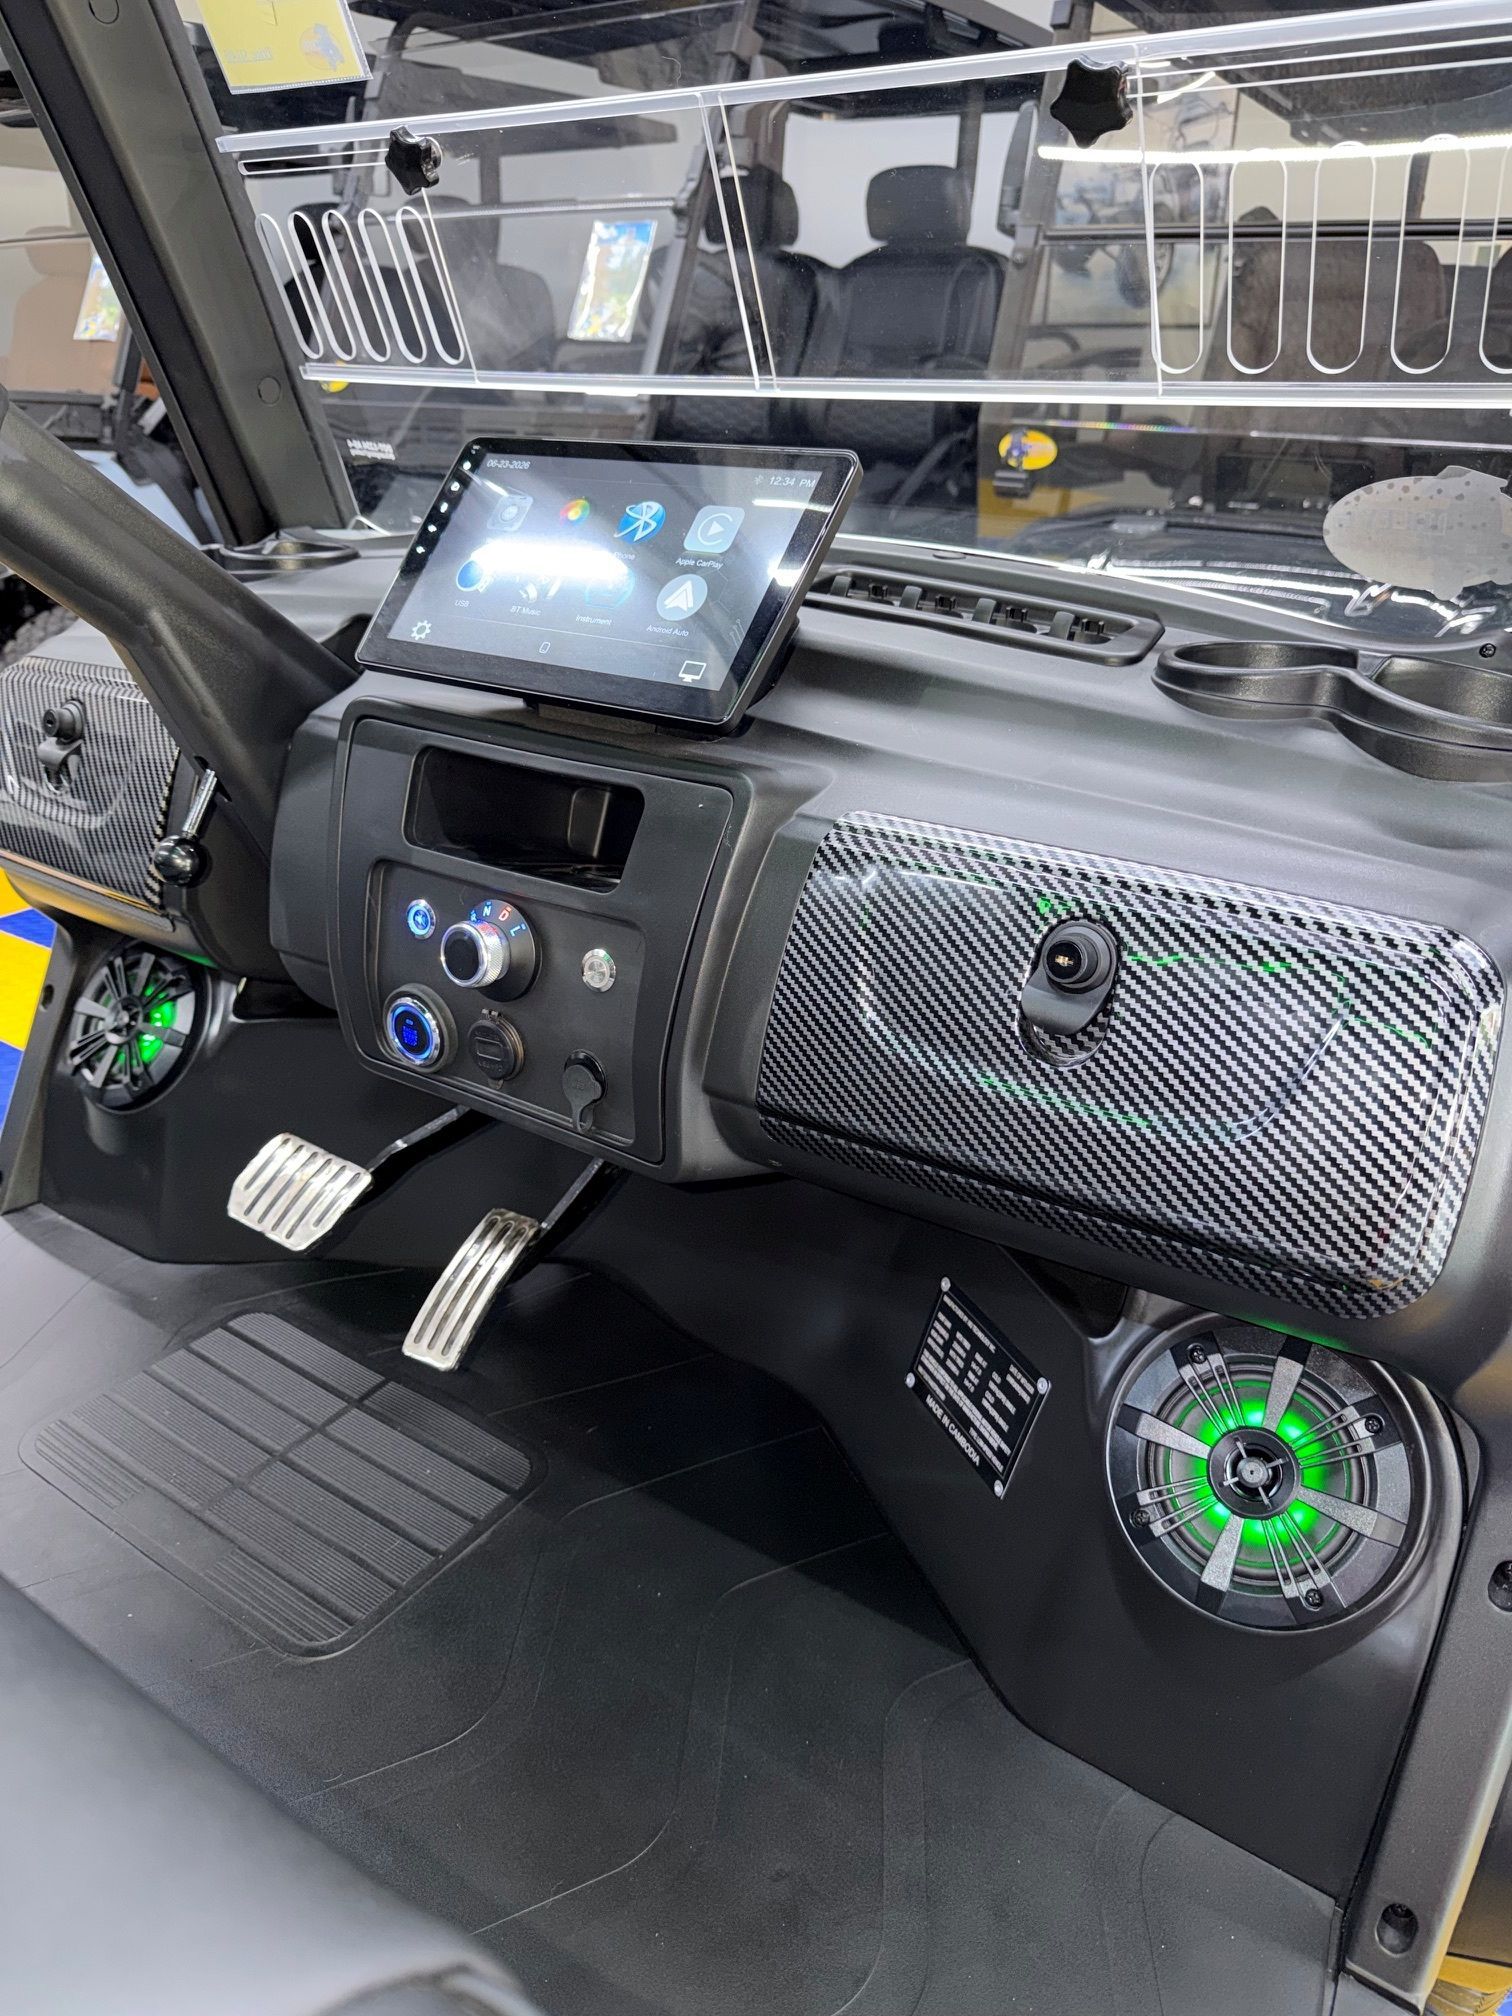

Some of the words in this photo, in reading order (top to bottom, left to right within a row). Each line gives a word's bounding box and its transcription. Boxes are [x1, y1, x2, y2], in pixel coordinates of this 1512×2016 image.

[486, 459, 531, 470] 06-23-2026
[799, 478, 816, 488] PM
[676, 557, 695, 568] Apple
[696, 560, 724, 570] CarPlay
[510, 605, 522, 614] BT
[522, 608, 542, 616] Music
[576, 615, 612, 626] Instrument
[646, 624, 672, 635] Android
[672, 628, 689, 638] Auto
[482, 906, 492, 916] N
[498, 909, 510, 922] D
[510, 926, 520, 936] L
[926, 1394, 942, 1420] MADE
[941, 1413, 950, 1428] IN
[948, 1423, 980, 1466] CAMBODIA
